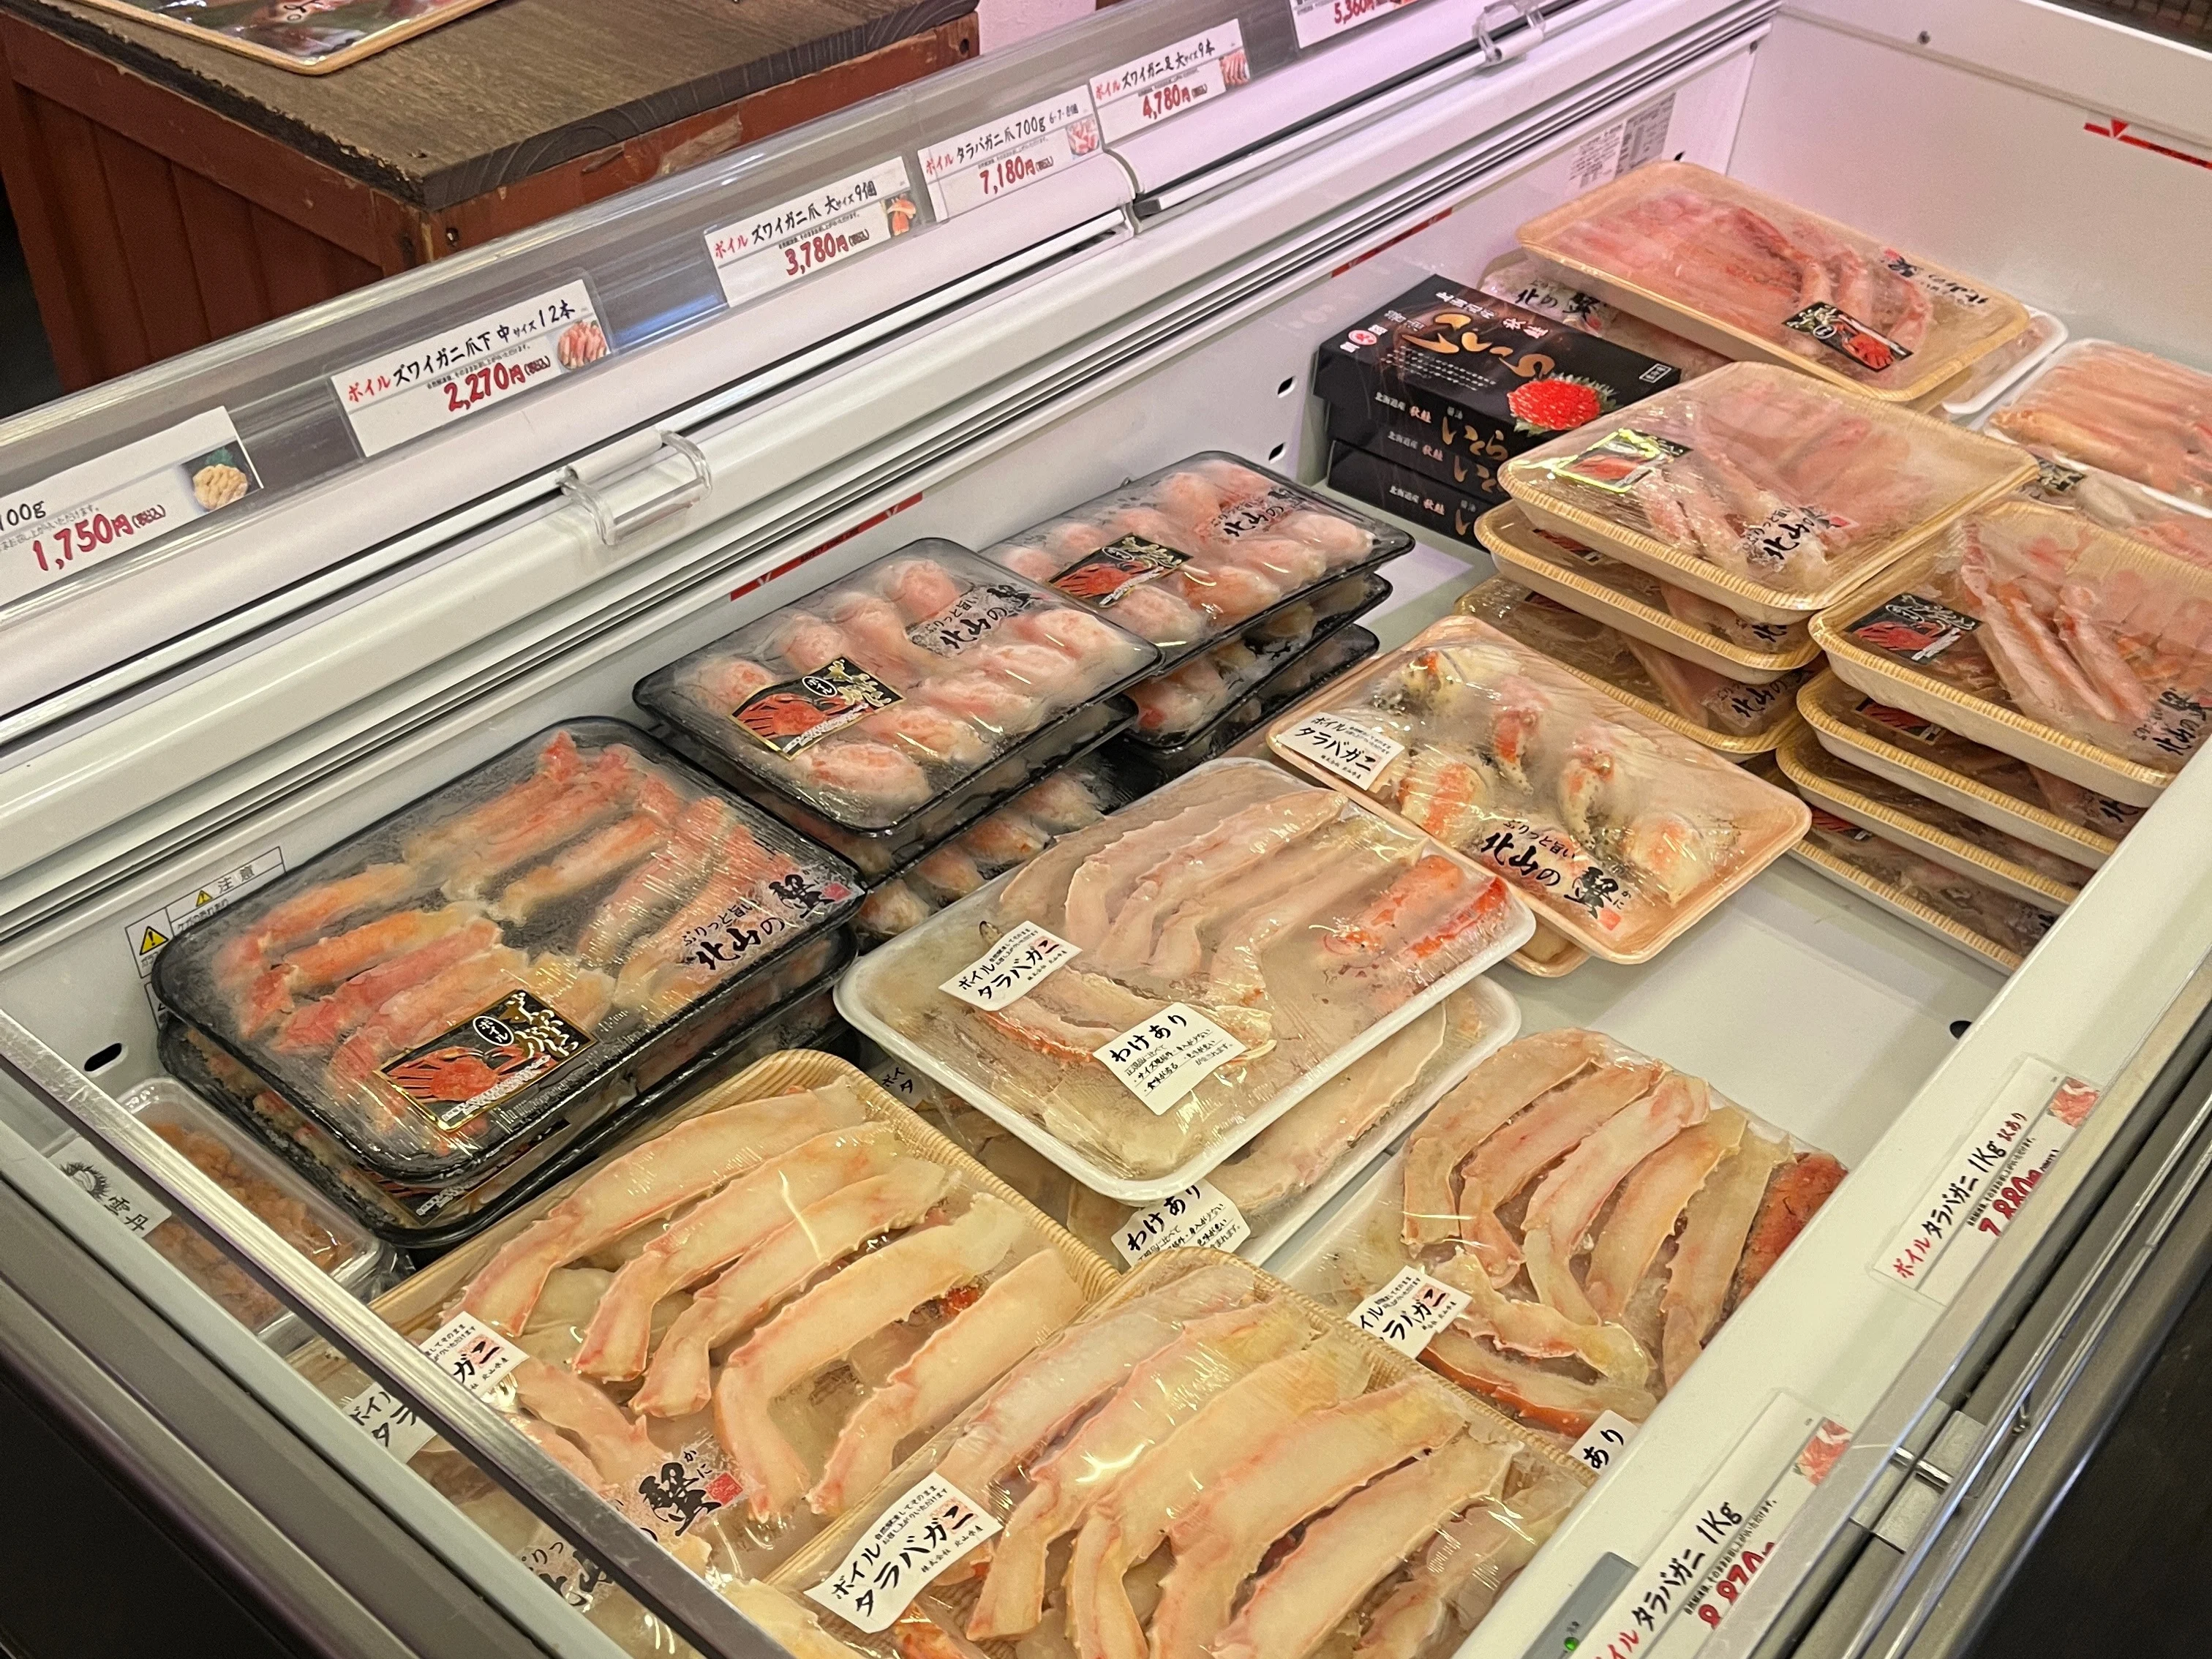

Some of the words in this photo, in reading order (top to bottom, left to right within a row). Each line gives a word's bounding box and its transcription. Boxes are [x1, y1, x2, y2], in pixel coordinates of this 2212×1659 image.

[926, 154, 954, 176] ボイル
[714, 234, 748, 259] ボイル
[348, 375, 391, 402] ボイル
[1454, 455, 1503, 494] いく
[808, 678, 832, 695] ボイル
[1311, 717, 1347, 731] ボイル
[1295, 727, 1377, 772] タラバガニ
[959, 963, 995, 990] ボイル
[978, 939, 1060, 999] タラバガニ
[478, 1017, 509, 1044] ボイル
[1109, 1014, 1187, 1062] わけあり
[1126, 1184, 1201, 1252] わけあり
[1893, 1237, 1931, 1279] ボイル
[1922, 1175, 1979, 1239] タラバガニ
[1380, 1288, 1446, 1340] ラバガニ
[453, 1341, 500, 1384] ガニ
[684, 1449, 712, 1478] かに
[1584, 1428, 1624, 1470] あり
[832, 1543, 881, 1599] ボイル
[855, 1505, 974, 1617] タラバガニ
[1631, 1549, 1705, 1631] タラバガニ
